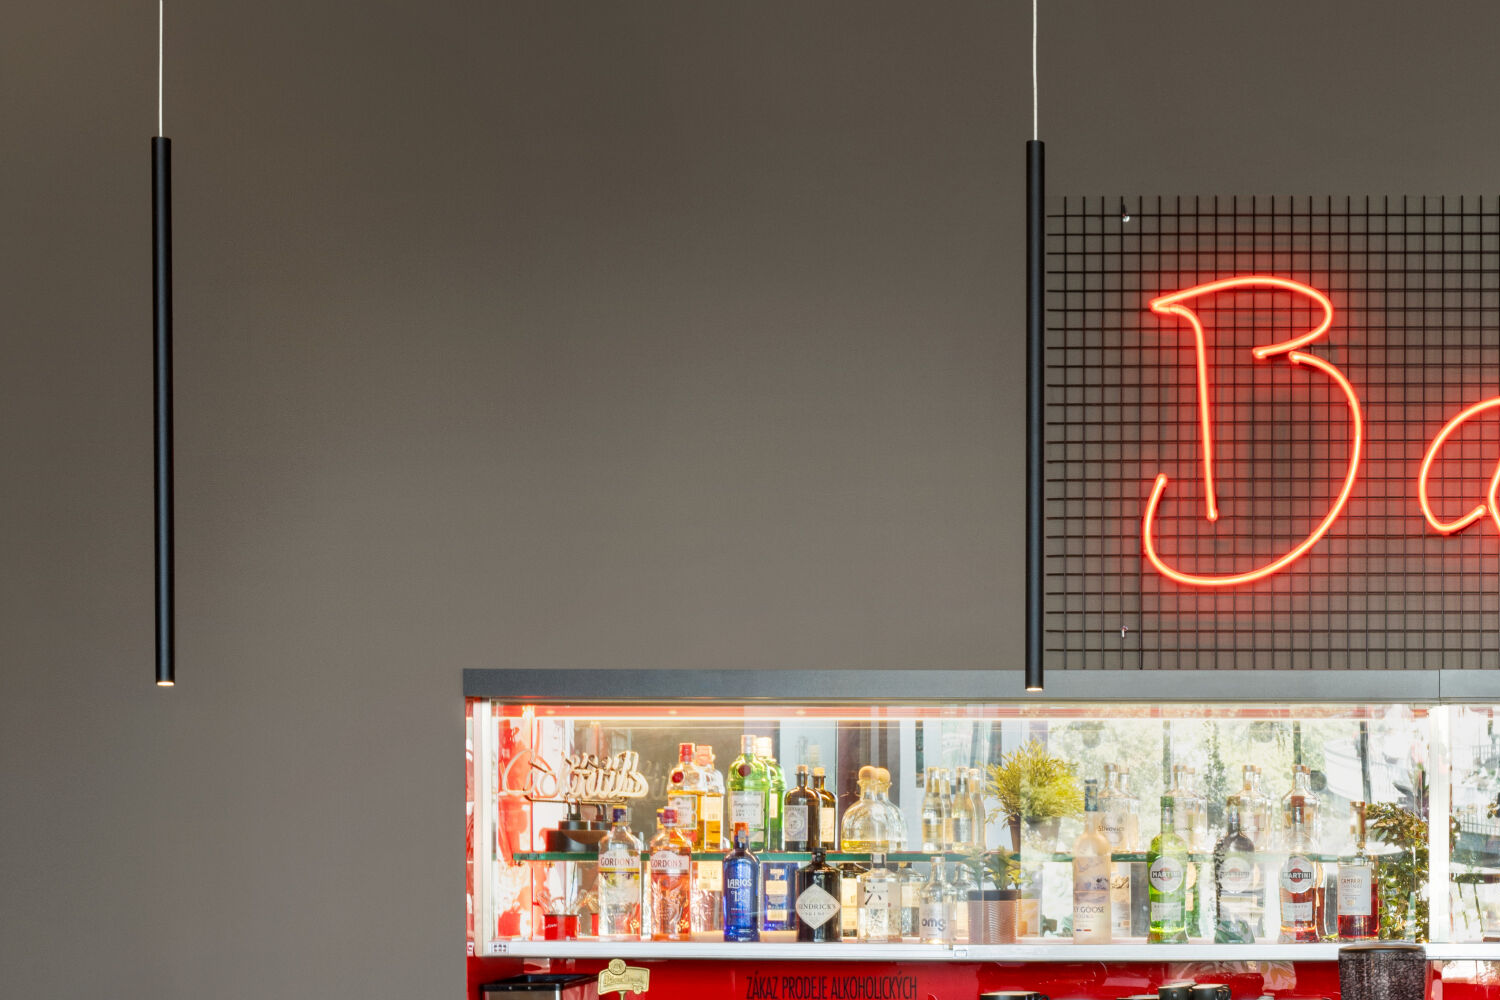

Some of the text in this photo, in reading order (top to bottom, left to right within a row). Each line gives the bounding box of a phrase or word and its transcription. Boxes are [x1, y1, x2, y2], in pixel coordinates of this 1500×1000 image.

[1283, 871, 1312, 880] MARTINI
[746, 970, 918, 1000] ZÁKAZ PRODEJE ALKOHOLICKÝCH
